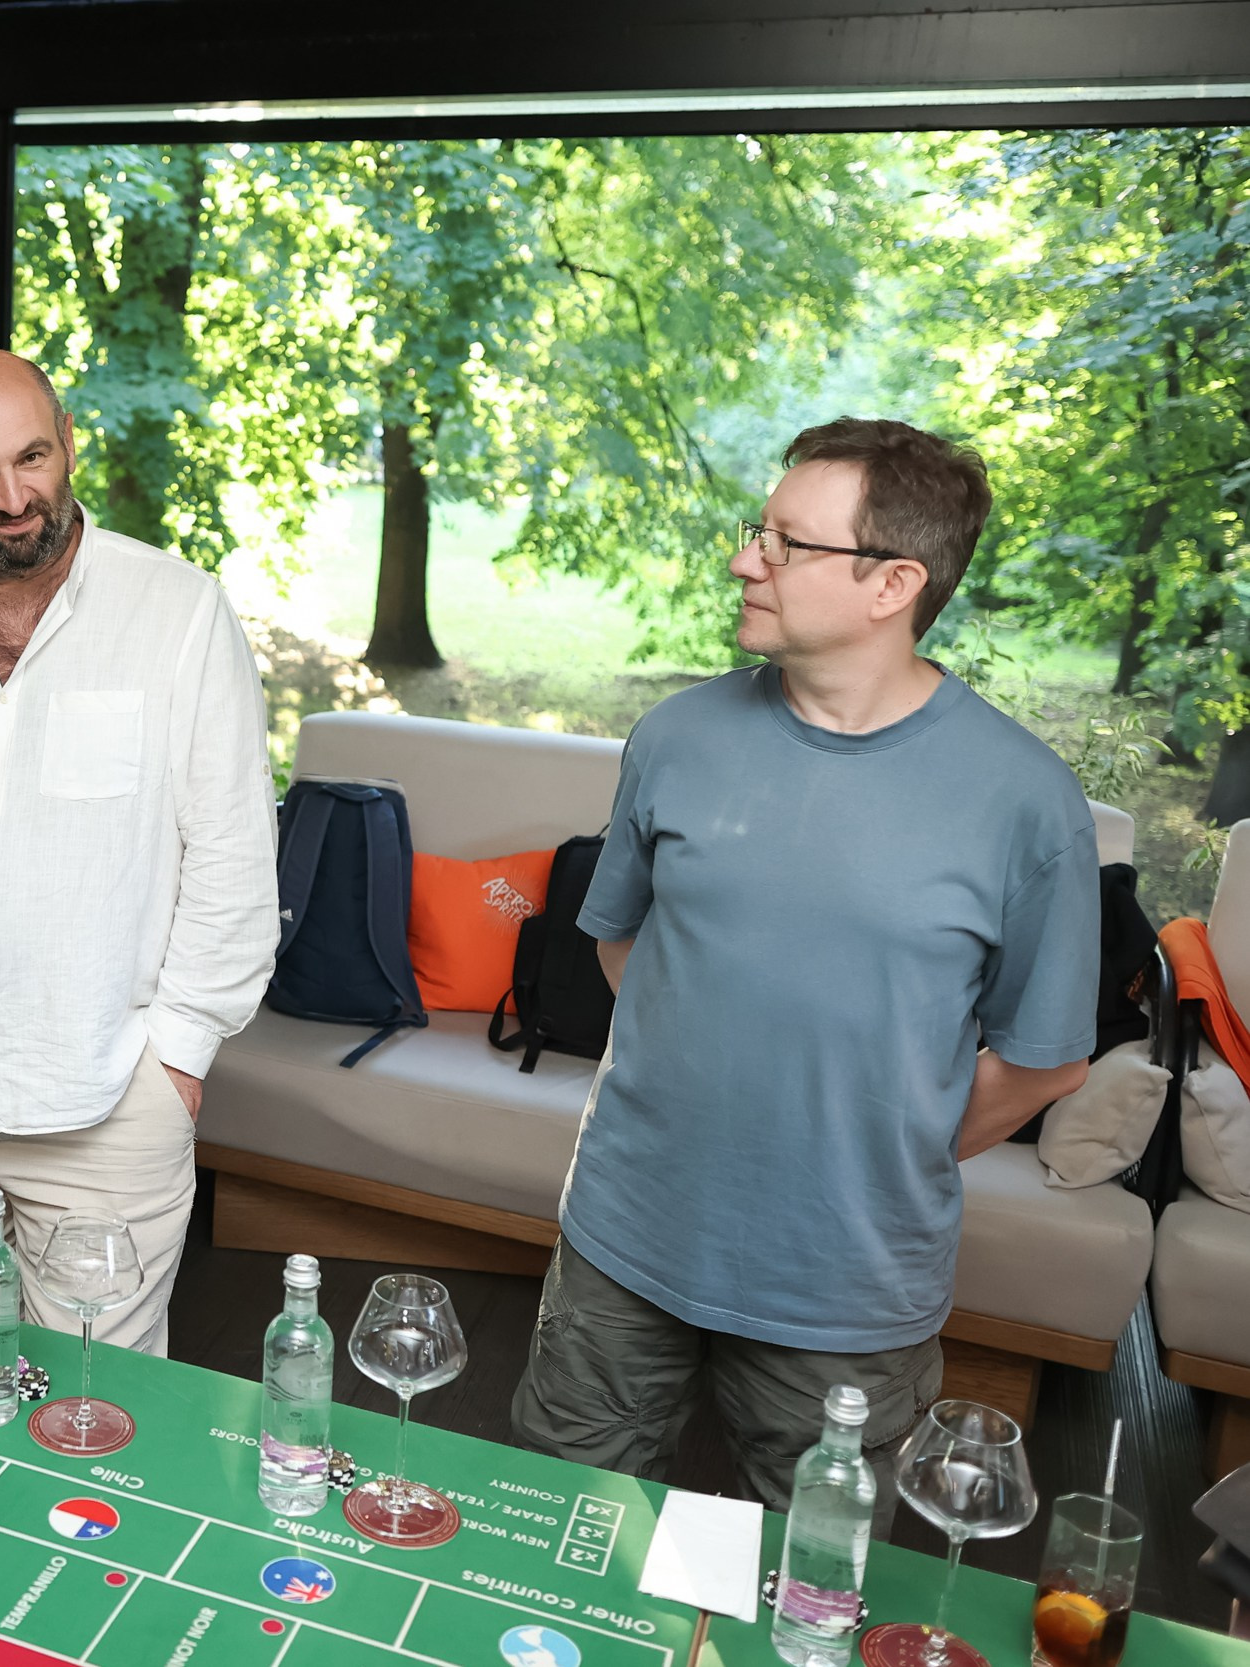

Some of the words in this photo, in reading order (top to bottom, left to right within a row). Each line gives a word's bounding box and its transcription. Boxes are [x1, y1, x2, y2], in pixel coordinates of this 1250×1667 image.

[481, 877, 537, 918] APEROL
[90, 1465, 144, 1490] Chile
[446, 1489, 485, 1509] YEAR
[488, 1478, 566, 1504] COUNTRY
[503, 1504, 558, 1526] GRAPE
[584, 1503, 614, 1517] x4
[273, 1517, 375, 1554] Australia
[460, 1517, 507, 1539] WORL
[511, 1531, 550, 1550] NEW
[577, 1525, 607, 1540] x3
[569, 1547, 599, 1563] x2
[0, 1555, 68, 1631] TEMPRANILLO
[461, 1568, 577, 1611] countries
[185, 1606, 219, 1640] NOIR
[582, 1603, 656, 1635] Other
